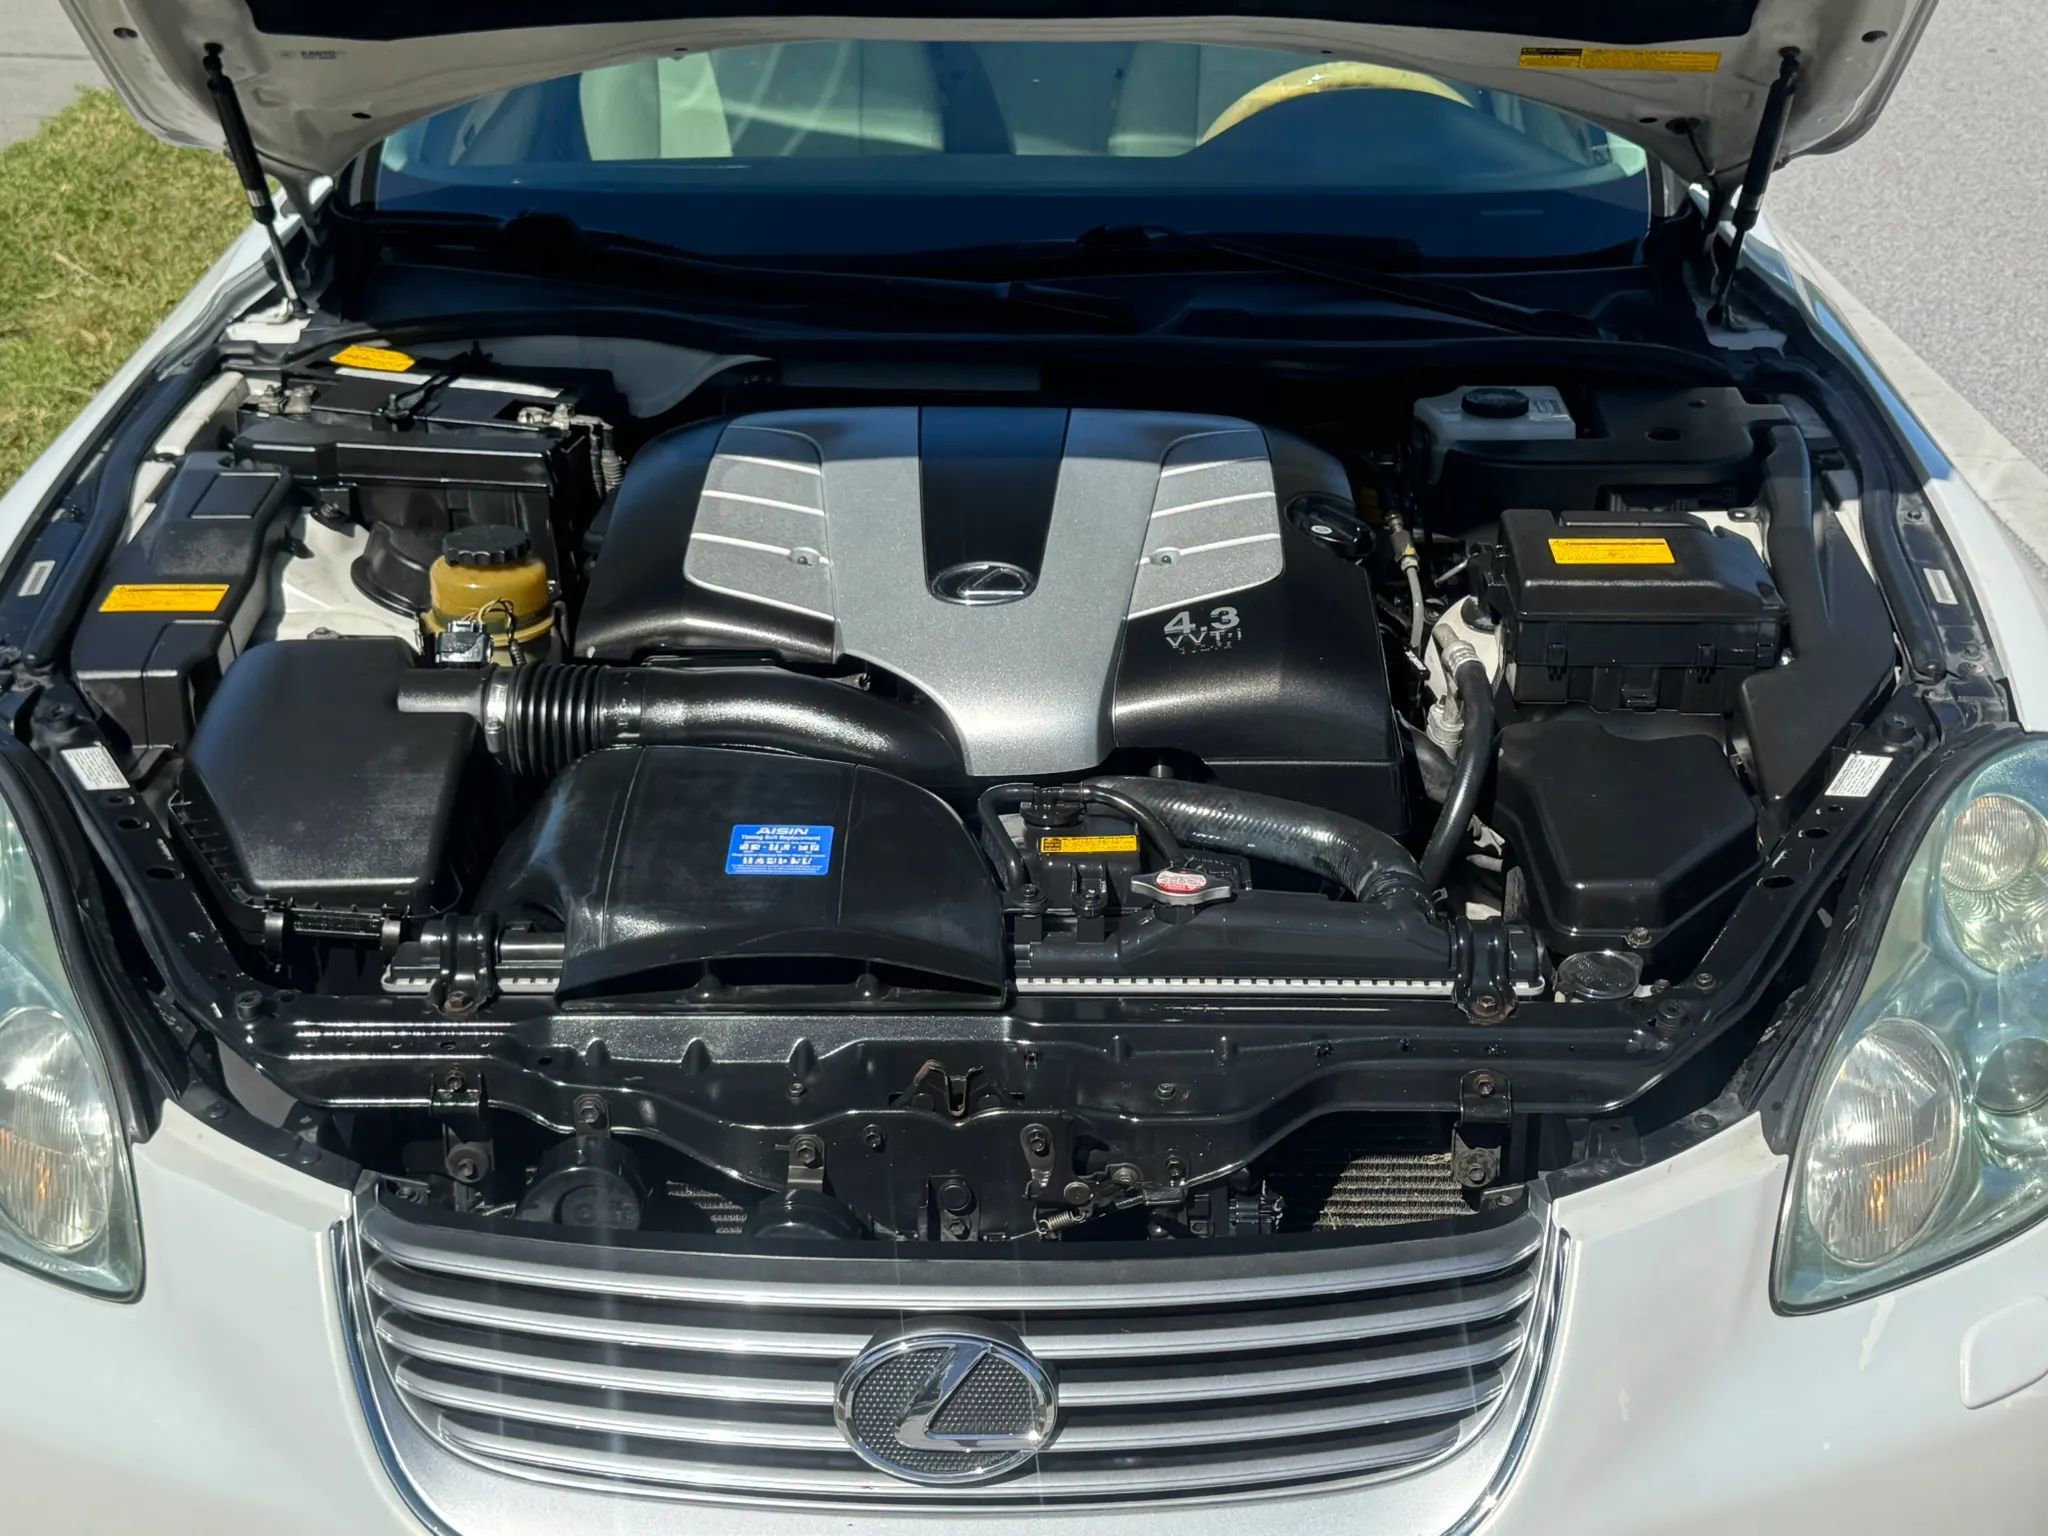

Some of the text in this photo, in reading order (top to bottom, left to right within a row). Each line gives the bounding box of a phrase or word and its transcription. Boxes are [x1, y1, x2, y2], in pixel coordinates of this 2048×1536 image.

[1164, 606, 1240, 634] 4.3
[756, 827, 809, 835] AISIN
[741, 834, 763, 842] Timing
